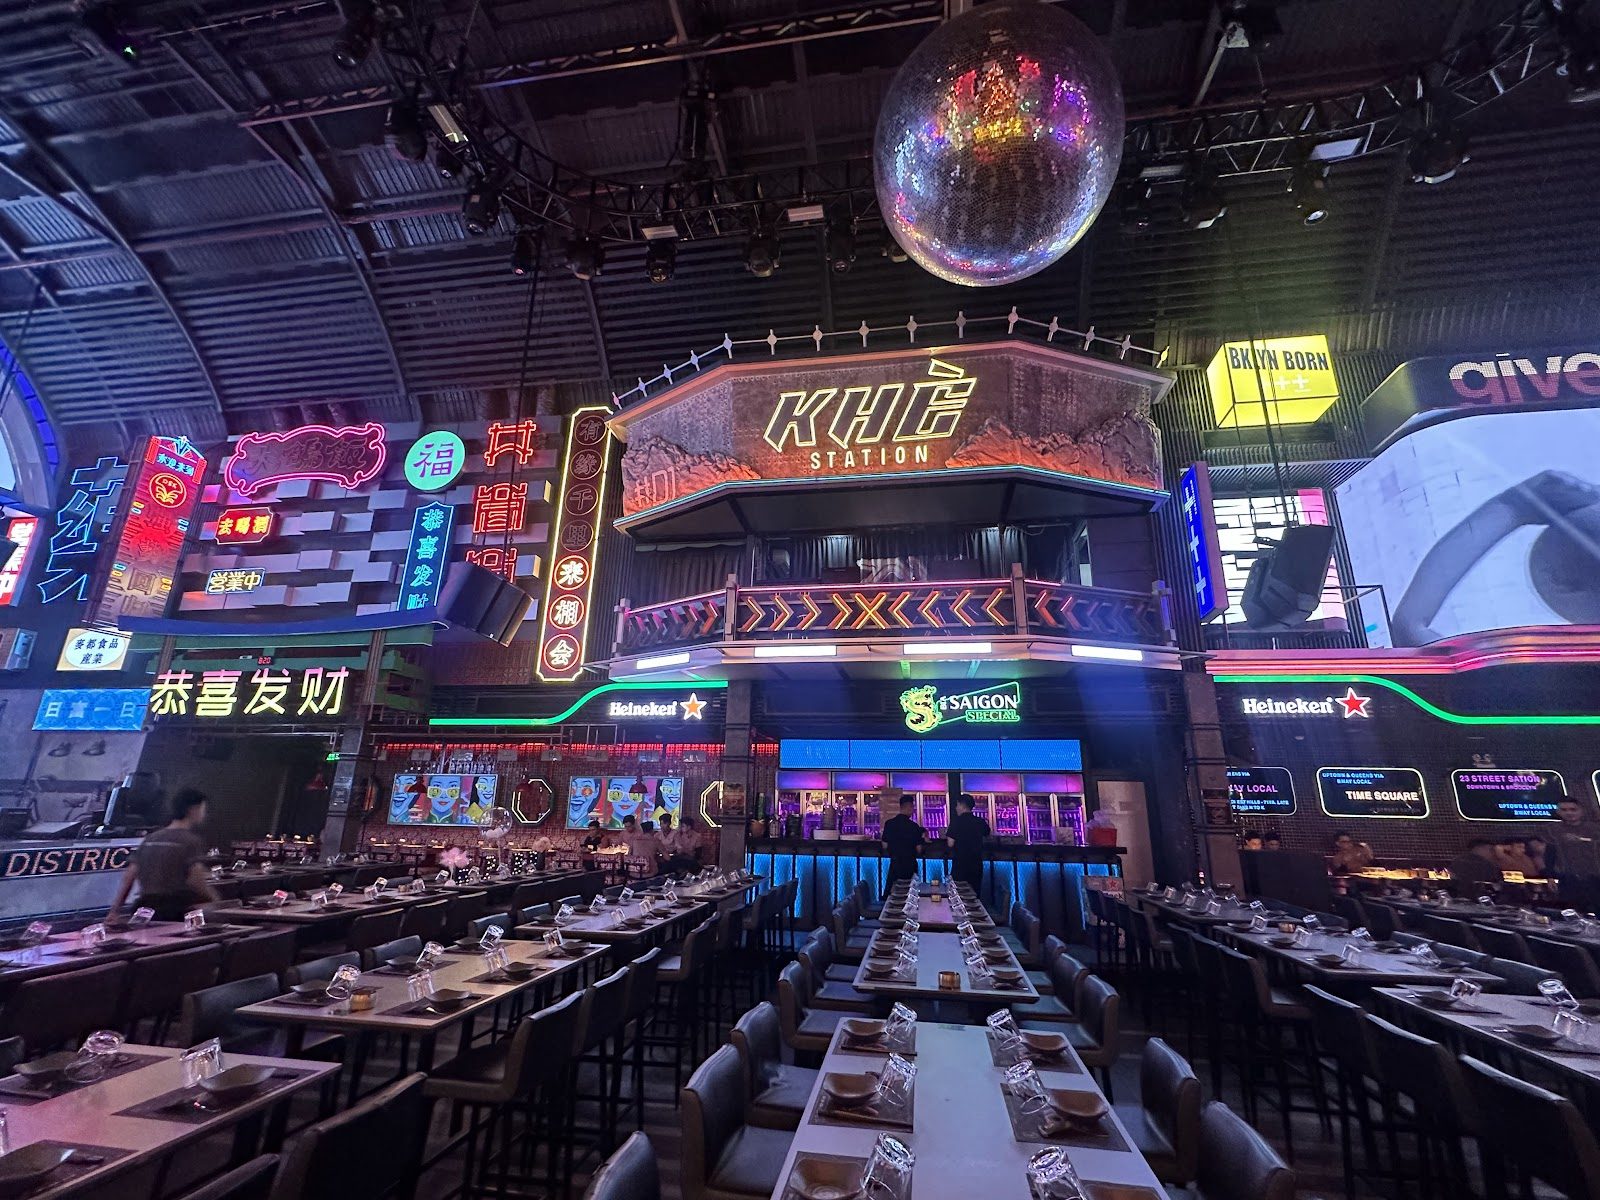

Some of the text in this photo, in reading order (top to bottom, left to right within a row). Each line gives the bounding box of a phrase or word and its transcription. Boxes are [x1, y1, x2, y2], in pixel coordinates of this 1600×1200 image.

[1228, 346, 1329, 371] BKYN BORN
[763, 359, 977, 453] KHÈ
[413, 443, 454, 478] 福
[810, 444, 928, 470] STATION
[150, 665, 350, 717] 恭喜发财
[609, 701, 677, 716] Heineken
[950, 694, 1018, 711] SAIGON
[1242, 697, 1334, 714] Heineken
[967, 710, 1018, 721] SPECIAL
[1471, 775, 1505, 783] STREET
[1508, 775, 1540, 783] SATION
[1246, 784, 1278, 793] LOCAL
[1345, 791, 1419, 801] TIME SQUARE
[5, 847, 139, 876] DISTRIC
